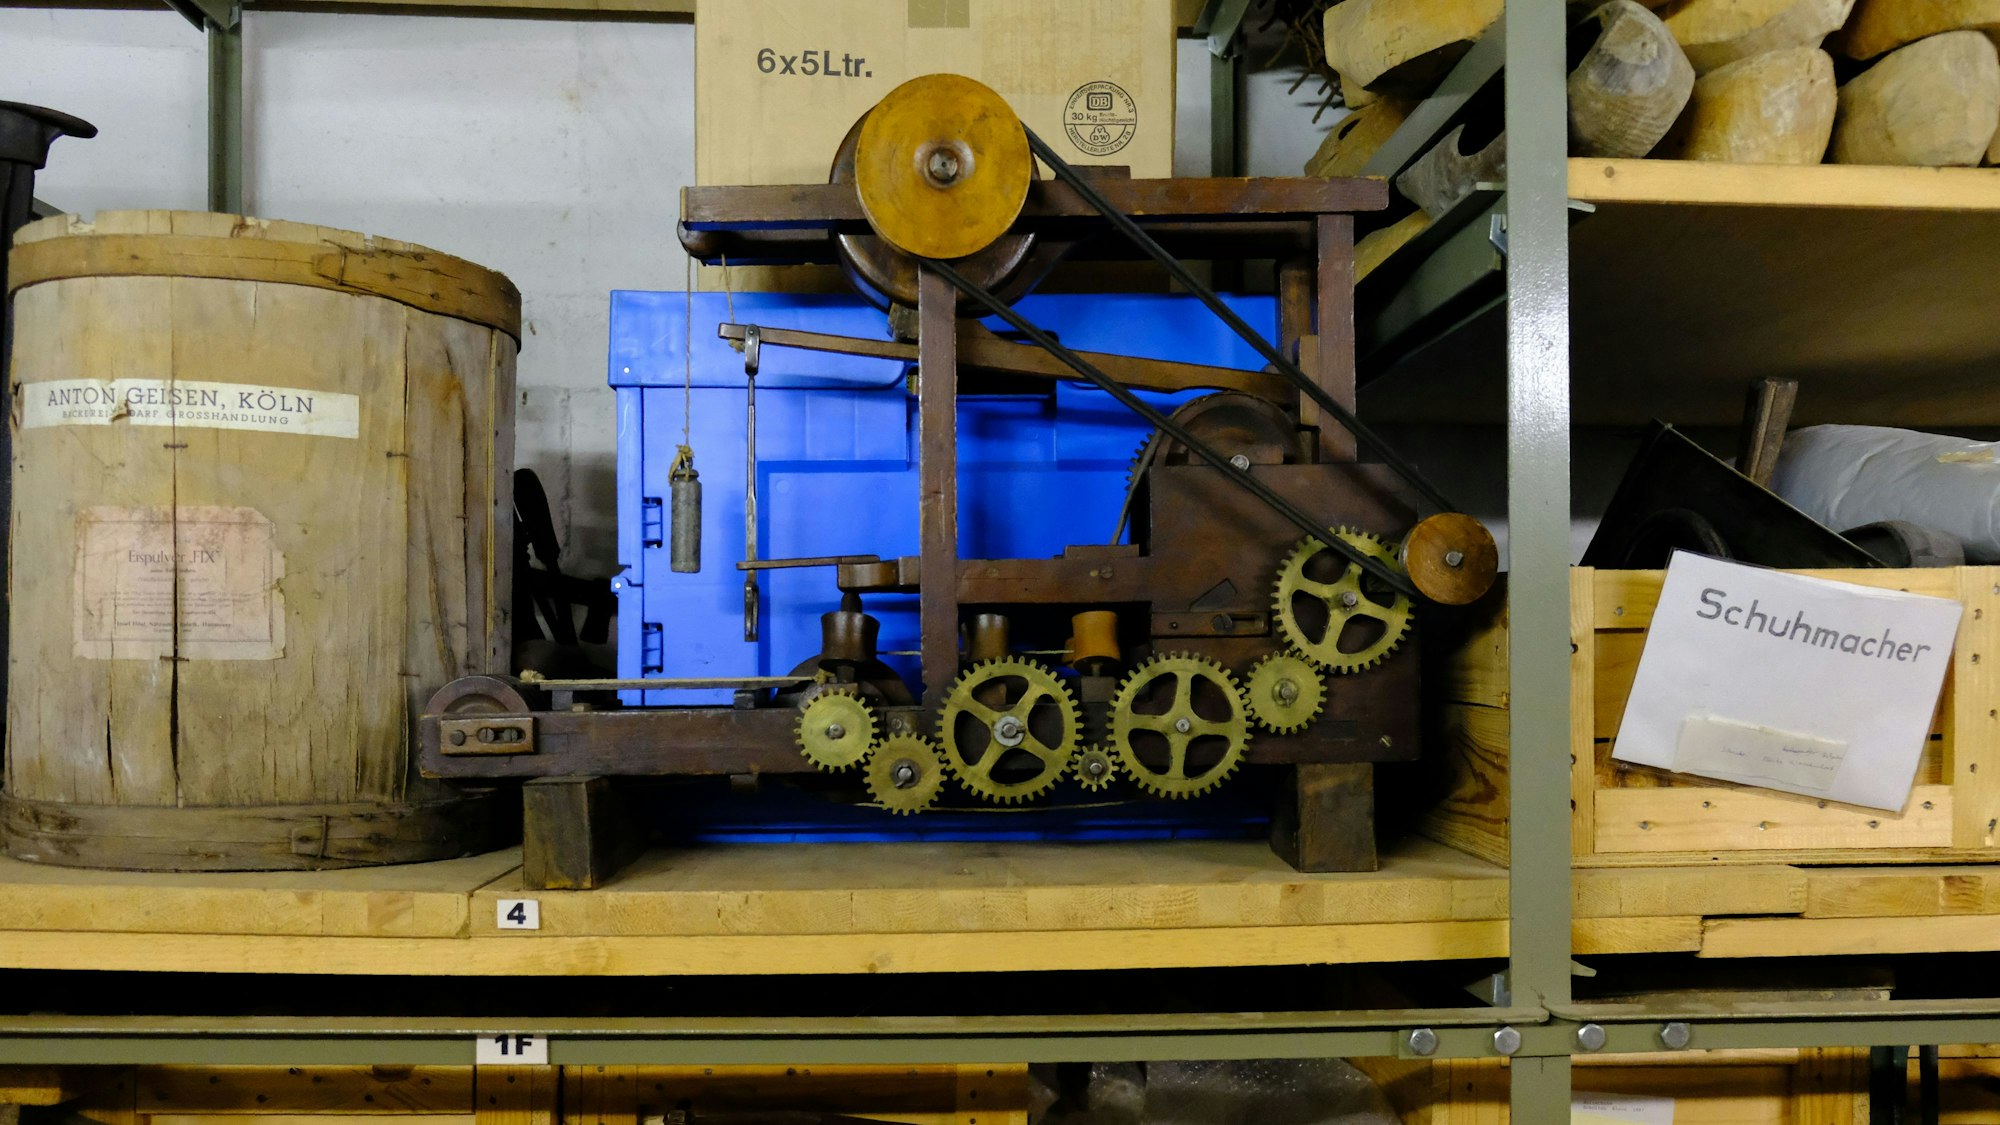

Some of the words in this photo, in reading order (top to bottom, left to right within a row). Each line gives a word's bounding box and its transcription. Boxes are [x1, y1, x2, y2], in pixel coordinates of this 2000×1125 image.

[1071, 112, 1084, 121] 30
[1086, 112, 1098, 123] kg
[48, 387, 116, 406] ANTON
[126, 387, 226, 410] GEISEN,
[238, 390, 314, 414] KÖLN
[166, 410, 289, 425] GROSSHANDLUNG
[1696, 588, 1931, 663] Schuhmacher
[507, 902, 526, 925] 4
[495, 1034, 534, 1055] 1F
